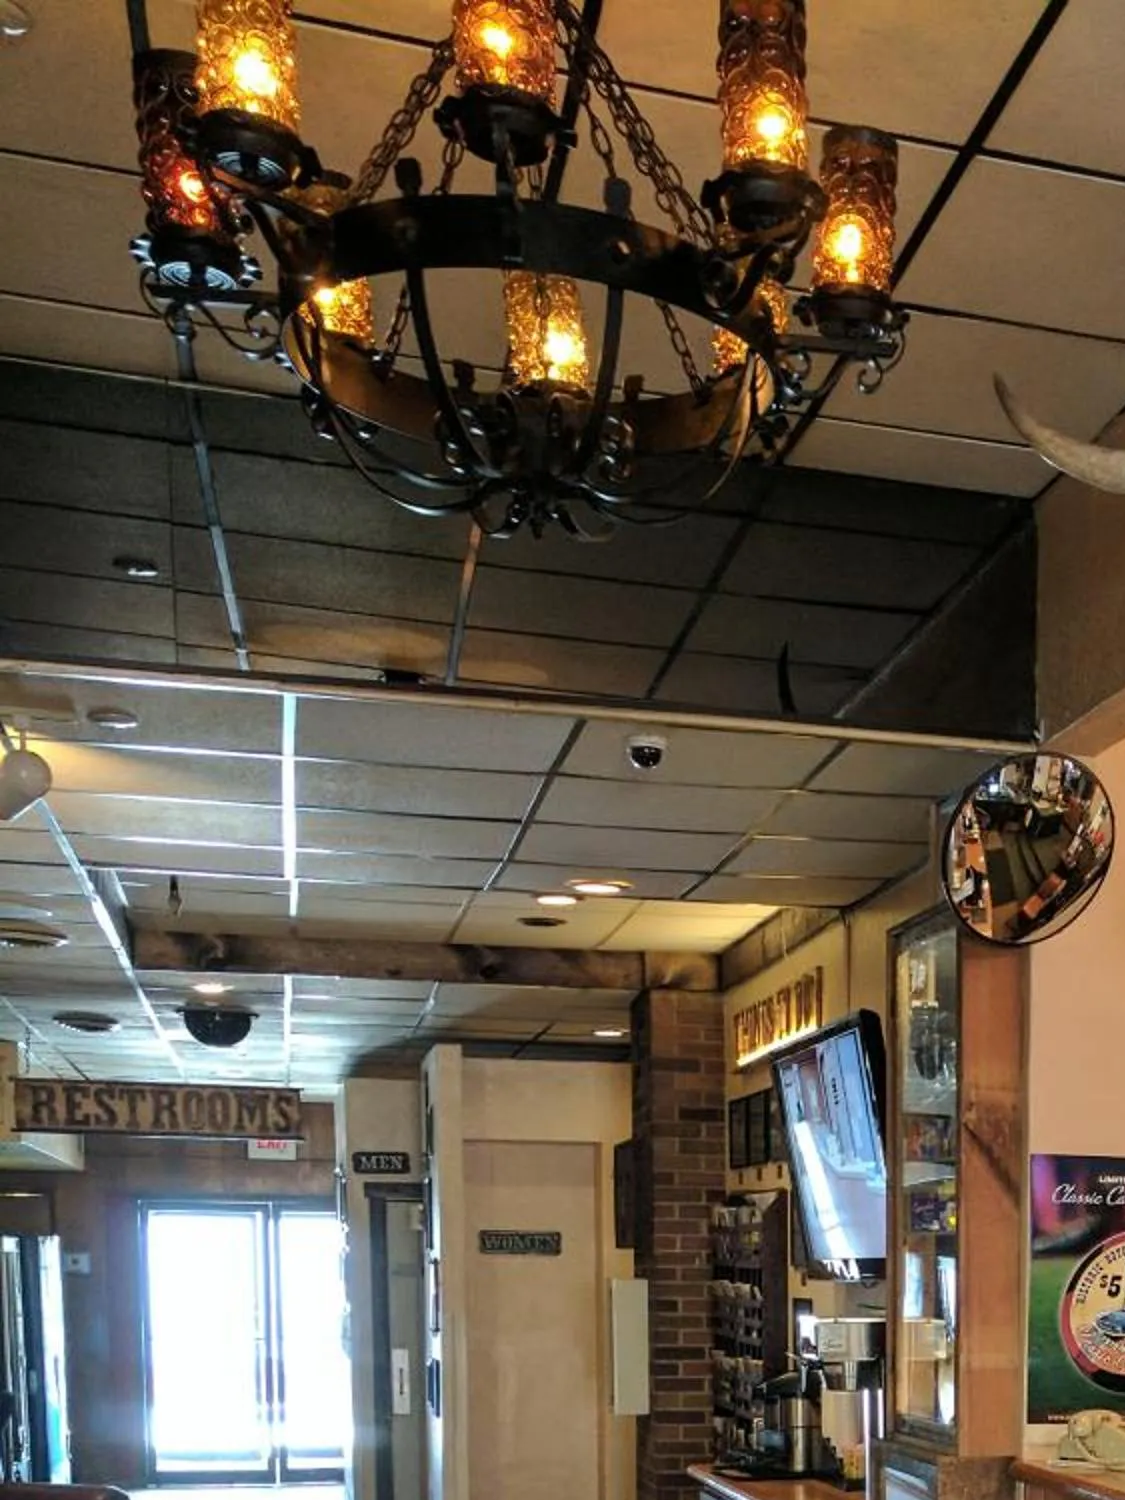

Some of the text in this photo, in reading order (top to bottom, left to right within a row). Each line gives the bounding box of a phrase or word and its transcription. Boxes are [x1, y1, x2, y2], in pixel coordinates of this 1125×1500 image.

[28, 1083, 293, 1133] RESTROOMS
[360, 1155, 403, 1170] MEN
[1051, 1183, 1103, 1206] Classic
[482, 1235, 560, 1250] WOMEN
[1100, 1273, 1123, 1298] $5
